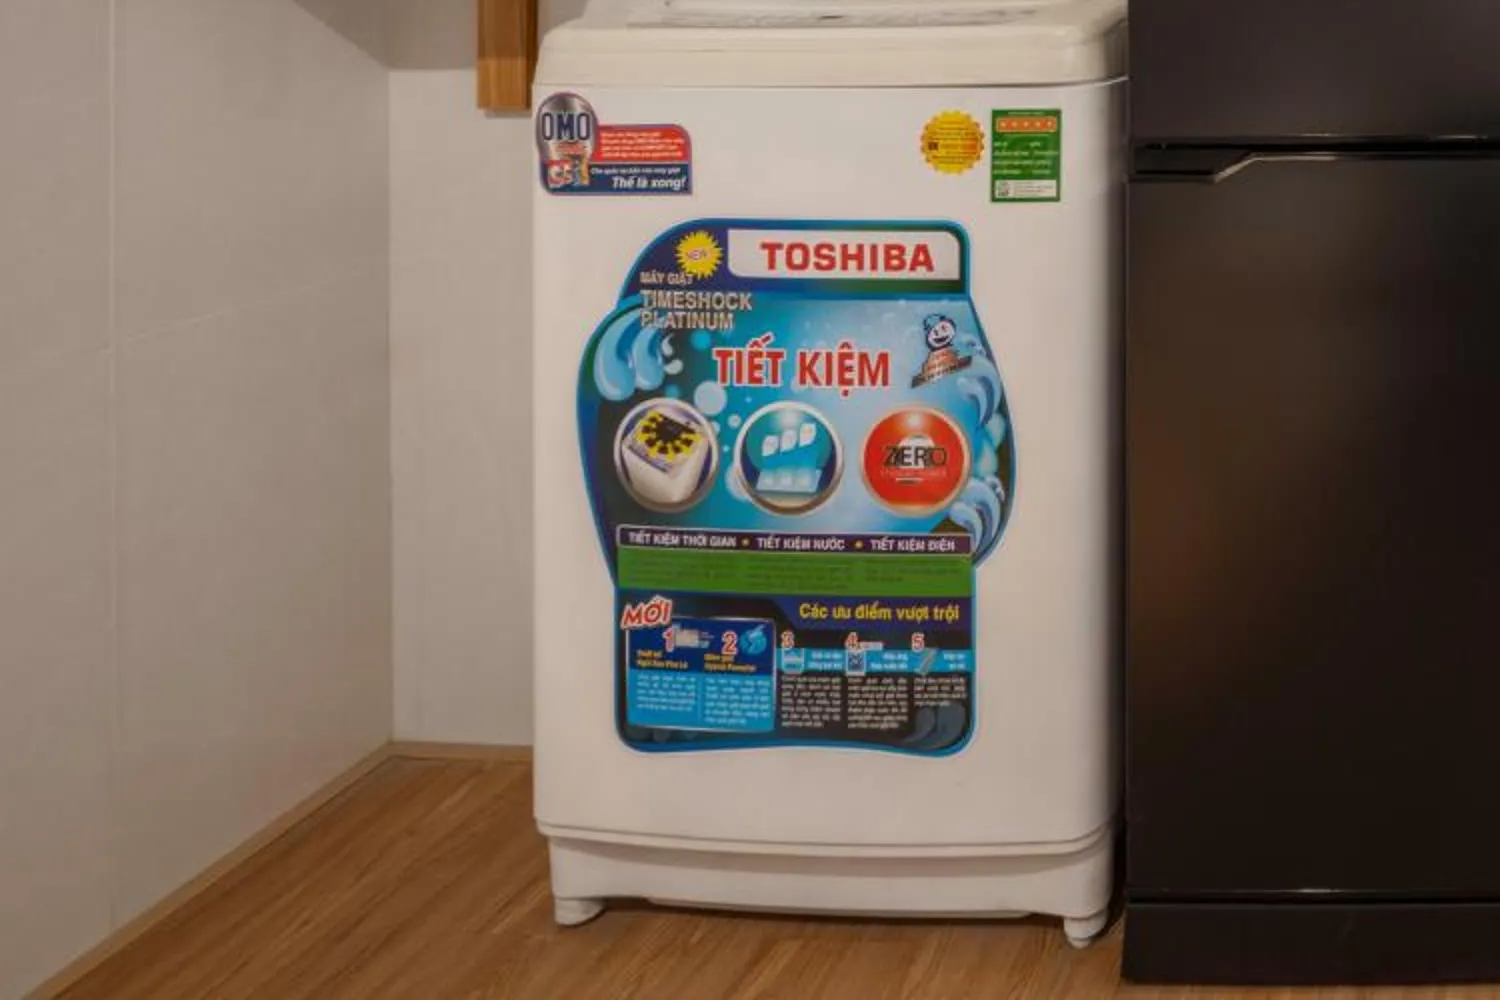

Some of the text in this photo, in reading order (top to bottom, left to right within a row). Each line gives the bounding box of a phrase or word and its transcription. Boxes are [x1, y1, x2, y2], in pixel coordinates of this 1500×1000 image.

[541, 111, 591, 141] OMO
[611, 175, 635, 189] Thế
[760, 241, 935, 272] TOSHIBA
[640, 289, 752, 311] TIMESHOCK
[640, 309, 734, 330] PLATINUM
[714, 335, 786, 386] TIẾT
[798, 341, 890, 397] KIỆM
[883, 444, 948, 468] ZERO
[709, 535, 737, 547] GIAN
[622, 596, 672, 628] MỚI
[799, 602, 829, 619] Các
[855, 600, 892, 620] điểm
[663, 627, 675, 652] 1
[721, 630, 738, 655] 2
[844, 631, 860, 651] 4
[911, 631, 926, 652] 5
